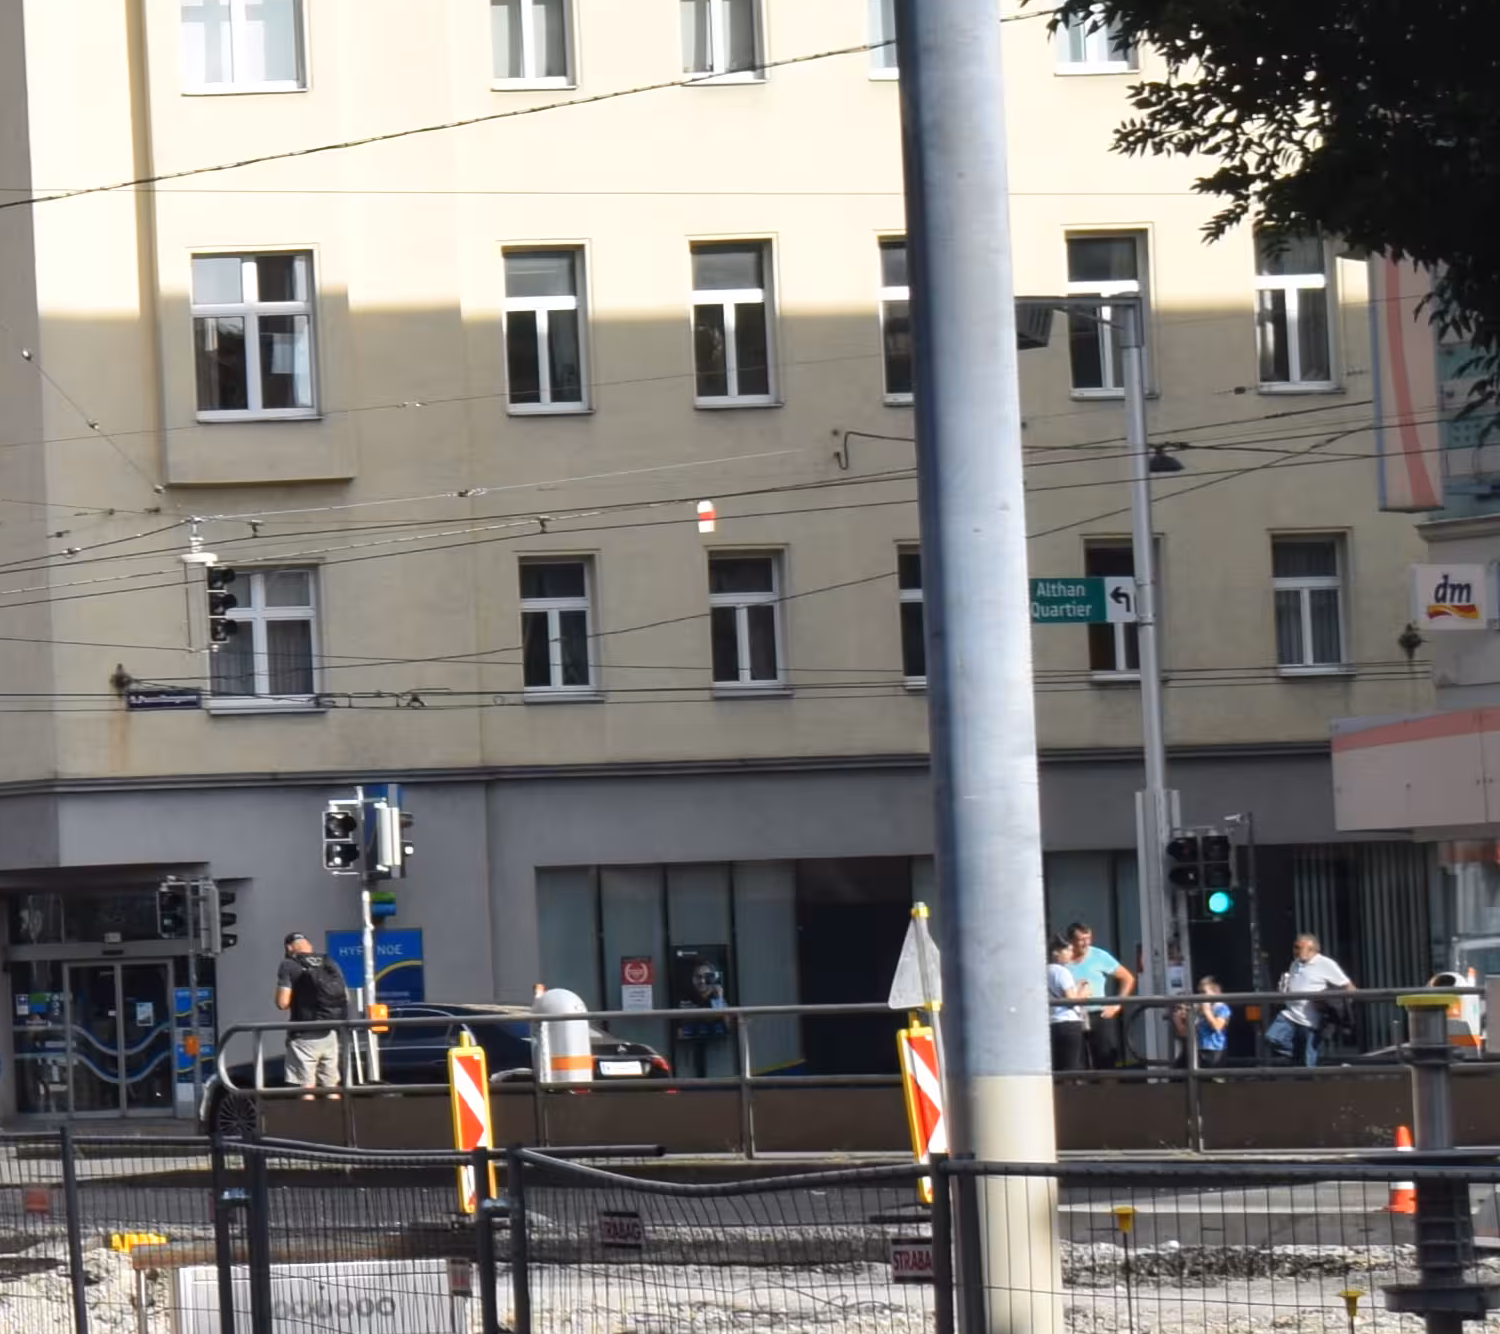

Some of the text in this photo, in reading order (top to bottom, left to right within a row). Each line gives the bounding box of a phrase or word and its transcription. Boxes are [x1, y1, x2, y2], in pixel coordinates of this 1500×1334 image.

[1035, 581, 1086, 598] Althan
[1434, 573, 1472, 604] dm
[1028, 600, 1093, 620] Quartier
[892, 1250, 933, 1271] STRABA
